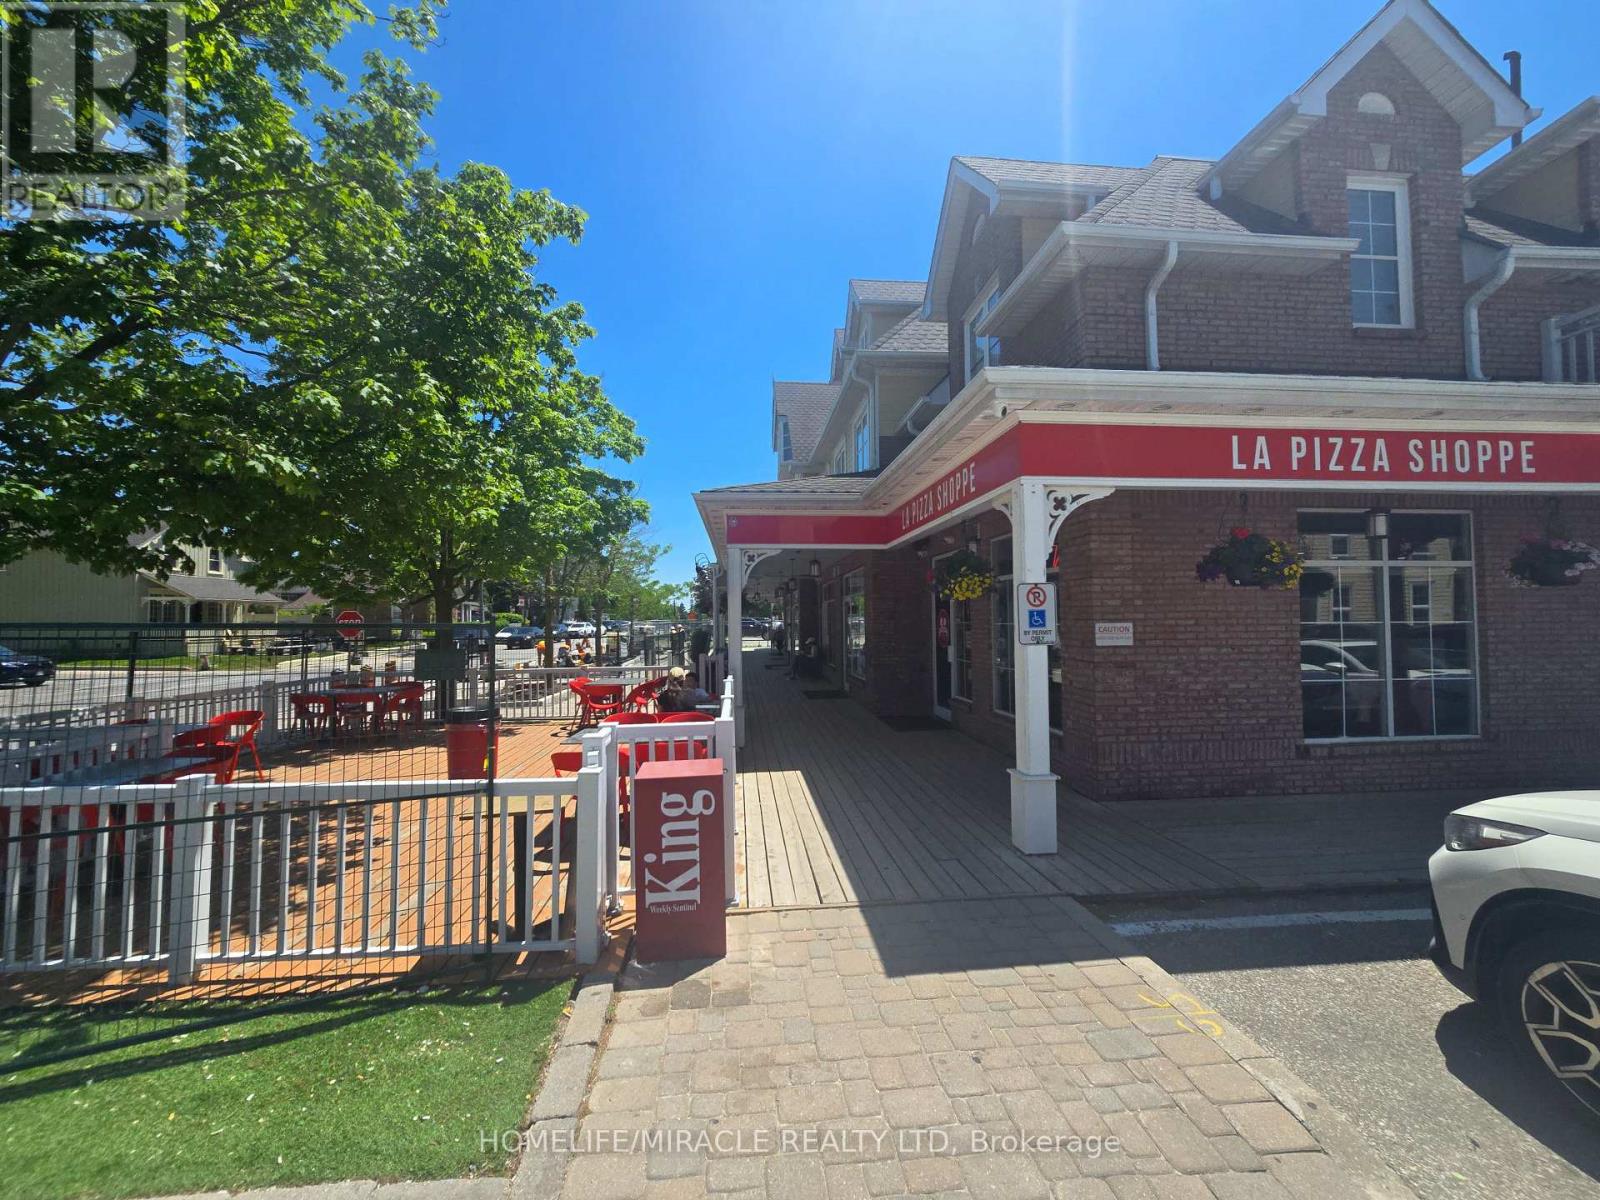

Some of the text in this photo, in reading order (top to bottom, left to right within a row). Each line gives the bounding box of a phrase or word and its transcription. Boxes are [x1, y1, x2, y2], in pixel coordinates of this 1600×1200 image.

[1231, 435, 1536, 473] LA PIZZA SHOPPE
[901, 461, 976, 530] LA PIZZA SHOPPE
[1098, 625, 1130, 633] CAUTION
[643, 789, 716, 908] King
[650, 901, 697, 915] Weekly Sentinel
